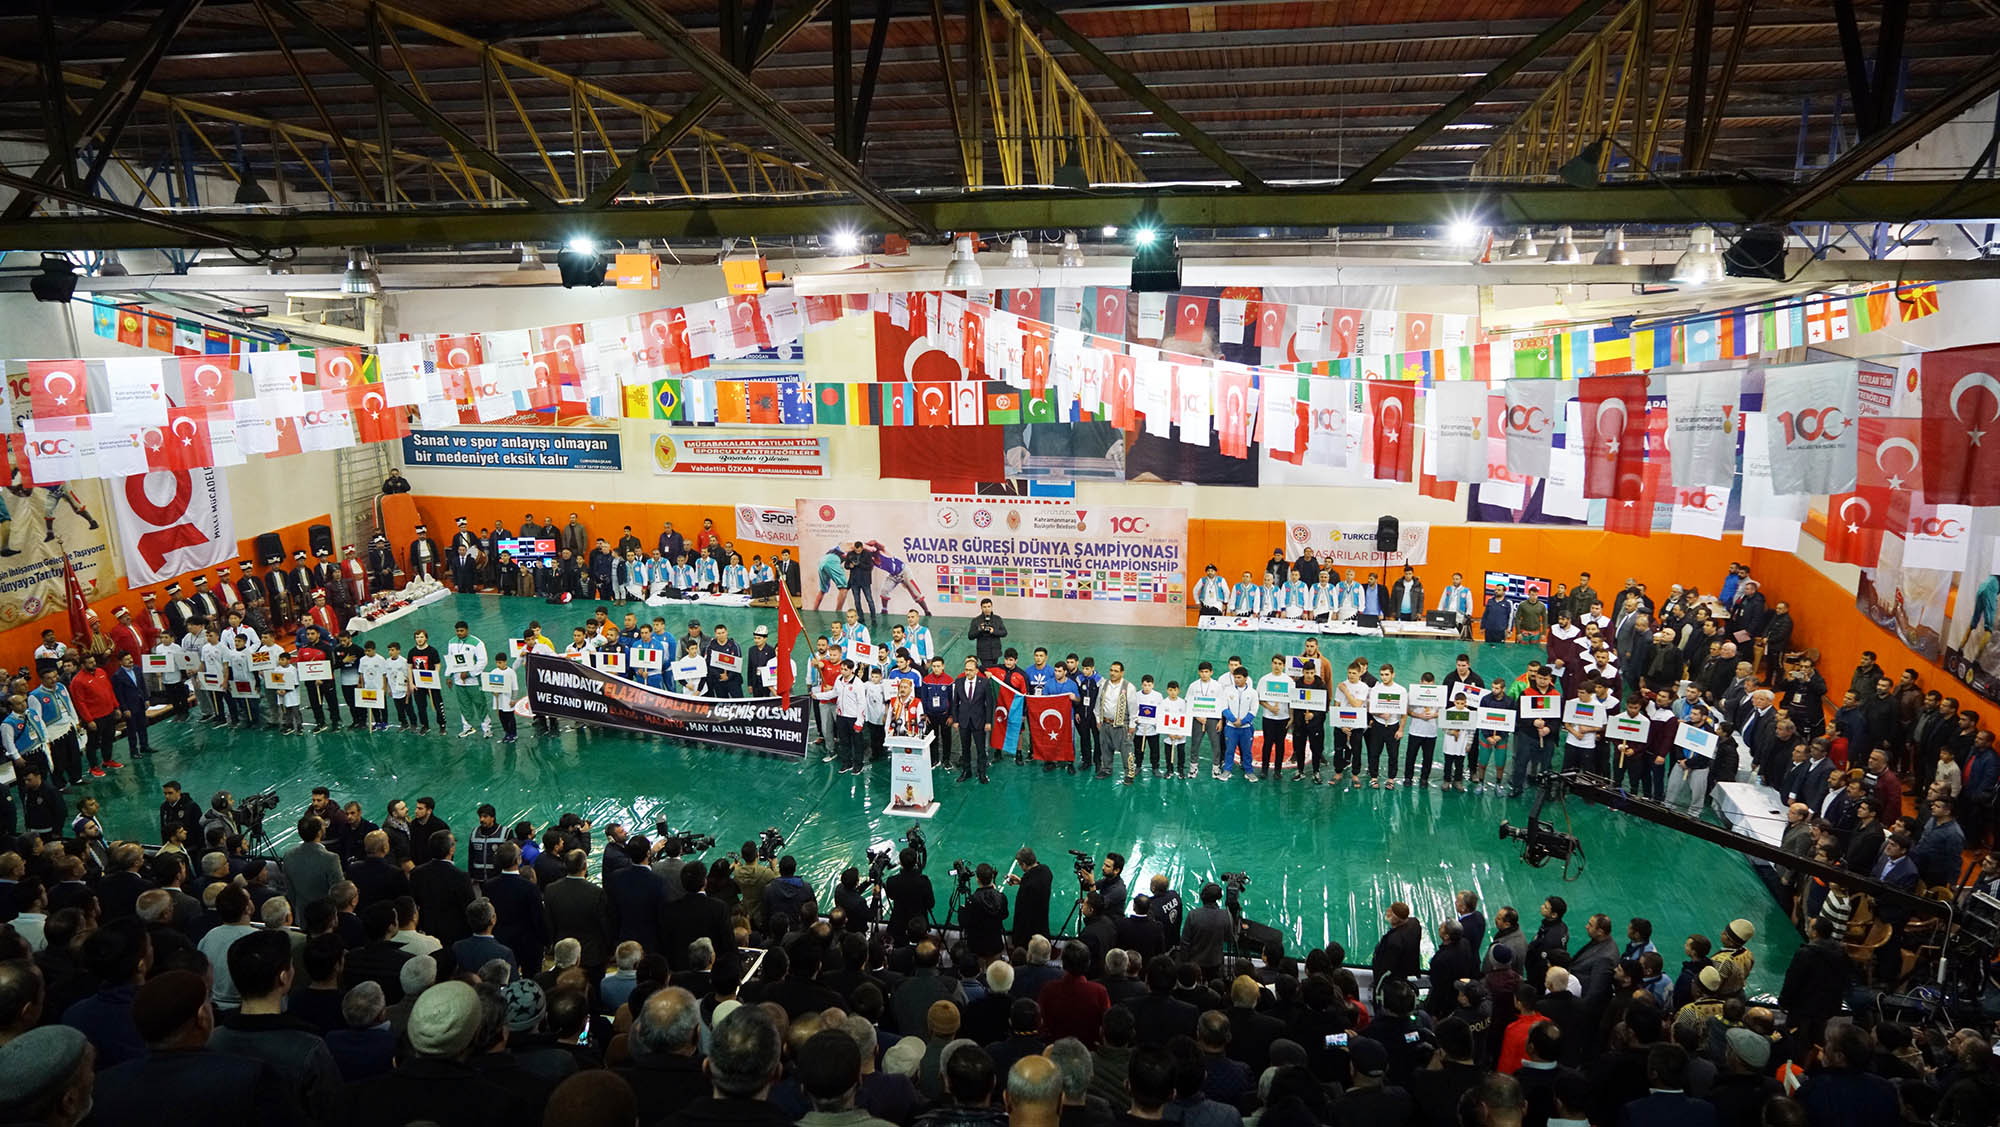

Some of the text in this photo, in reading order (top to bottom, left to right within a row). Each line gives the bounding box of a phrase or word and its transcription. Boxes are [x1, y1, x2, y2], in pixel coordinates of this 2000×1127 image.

[413, 433, 608, 452] Sanat ve spor anlayışı olmayan
[415, 450, 568, 466] bir medeniyet eksik kalır
[762, 513, 794, 524] SPOR
[755, 529, 799, 541] BAŞARILA
[903, 536, 1178, 560] ŞALVAR GÜREŞİ DÜNYA ŞAMPİYONASI
[906, 553, 949, 564] WORLD
[952, 554, 1009, 566] SHALWAR
[537, 668, 605, 695] YANINDAYIZ
[714, 702, 756, 721] GEÇMİŞ
[756, 705, 802, 723] OLSUN!
[536, 691, 551, 703] WE
[553, 695, 582, 708] STAND
[584, 700, 608, 713] WITH
[689, 722, 710, 732] MAY
[712, 725, 743, 734] ALLAH
[745, 727, 772, 739] BLESS
[774, 729, 802, 743] THEM!
